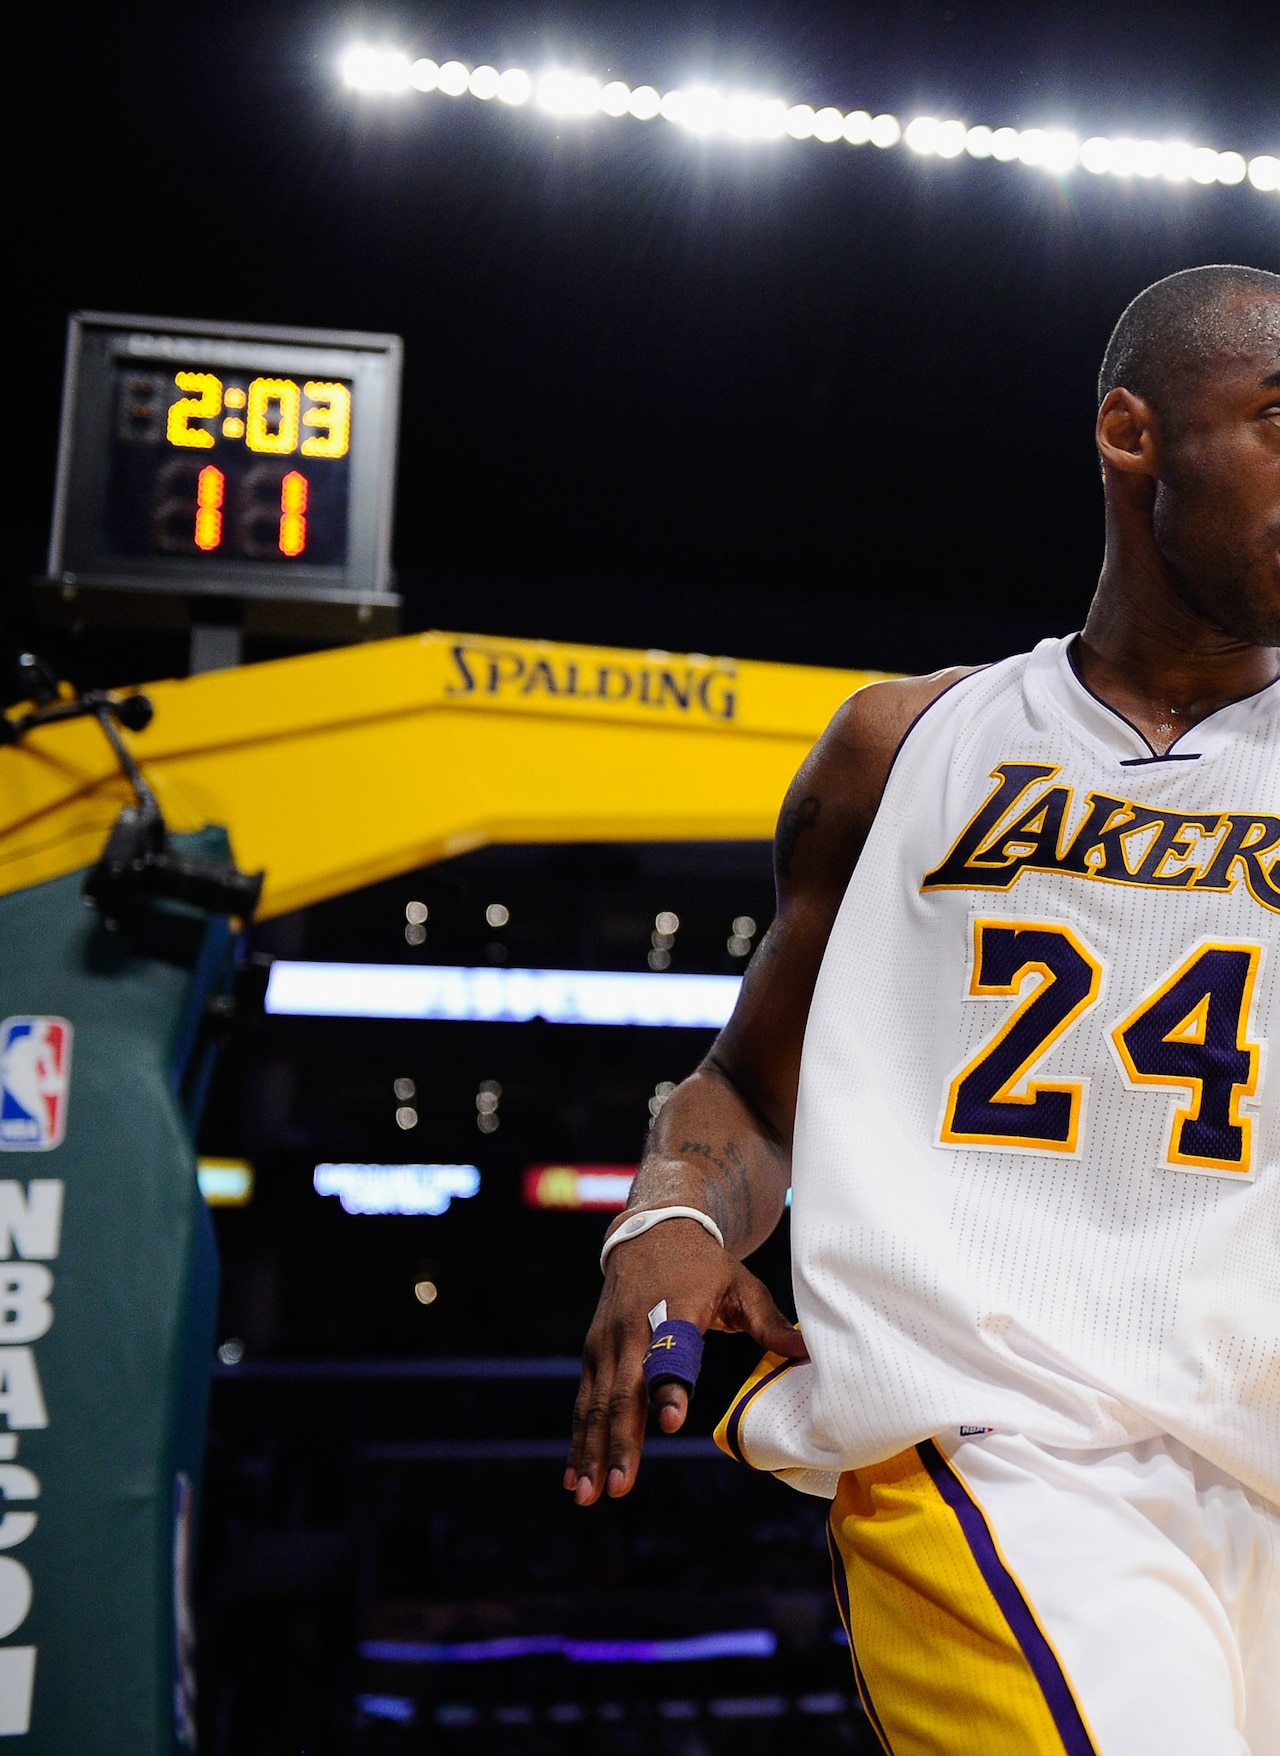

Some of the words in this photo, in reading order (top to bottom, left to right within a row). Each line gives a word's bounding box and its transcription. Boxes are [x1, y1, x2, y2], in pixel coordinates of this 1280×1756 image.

[166, 371, 350, 459] 2:03
[194, 464, 308, 557] 11
[443, 646, 738, 721] SPALDING
[938, 916, 1264, 1175] 24
